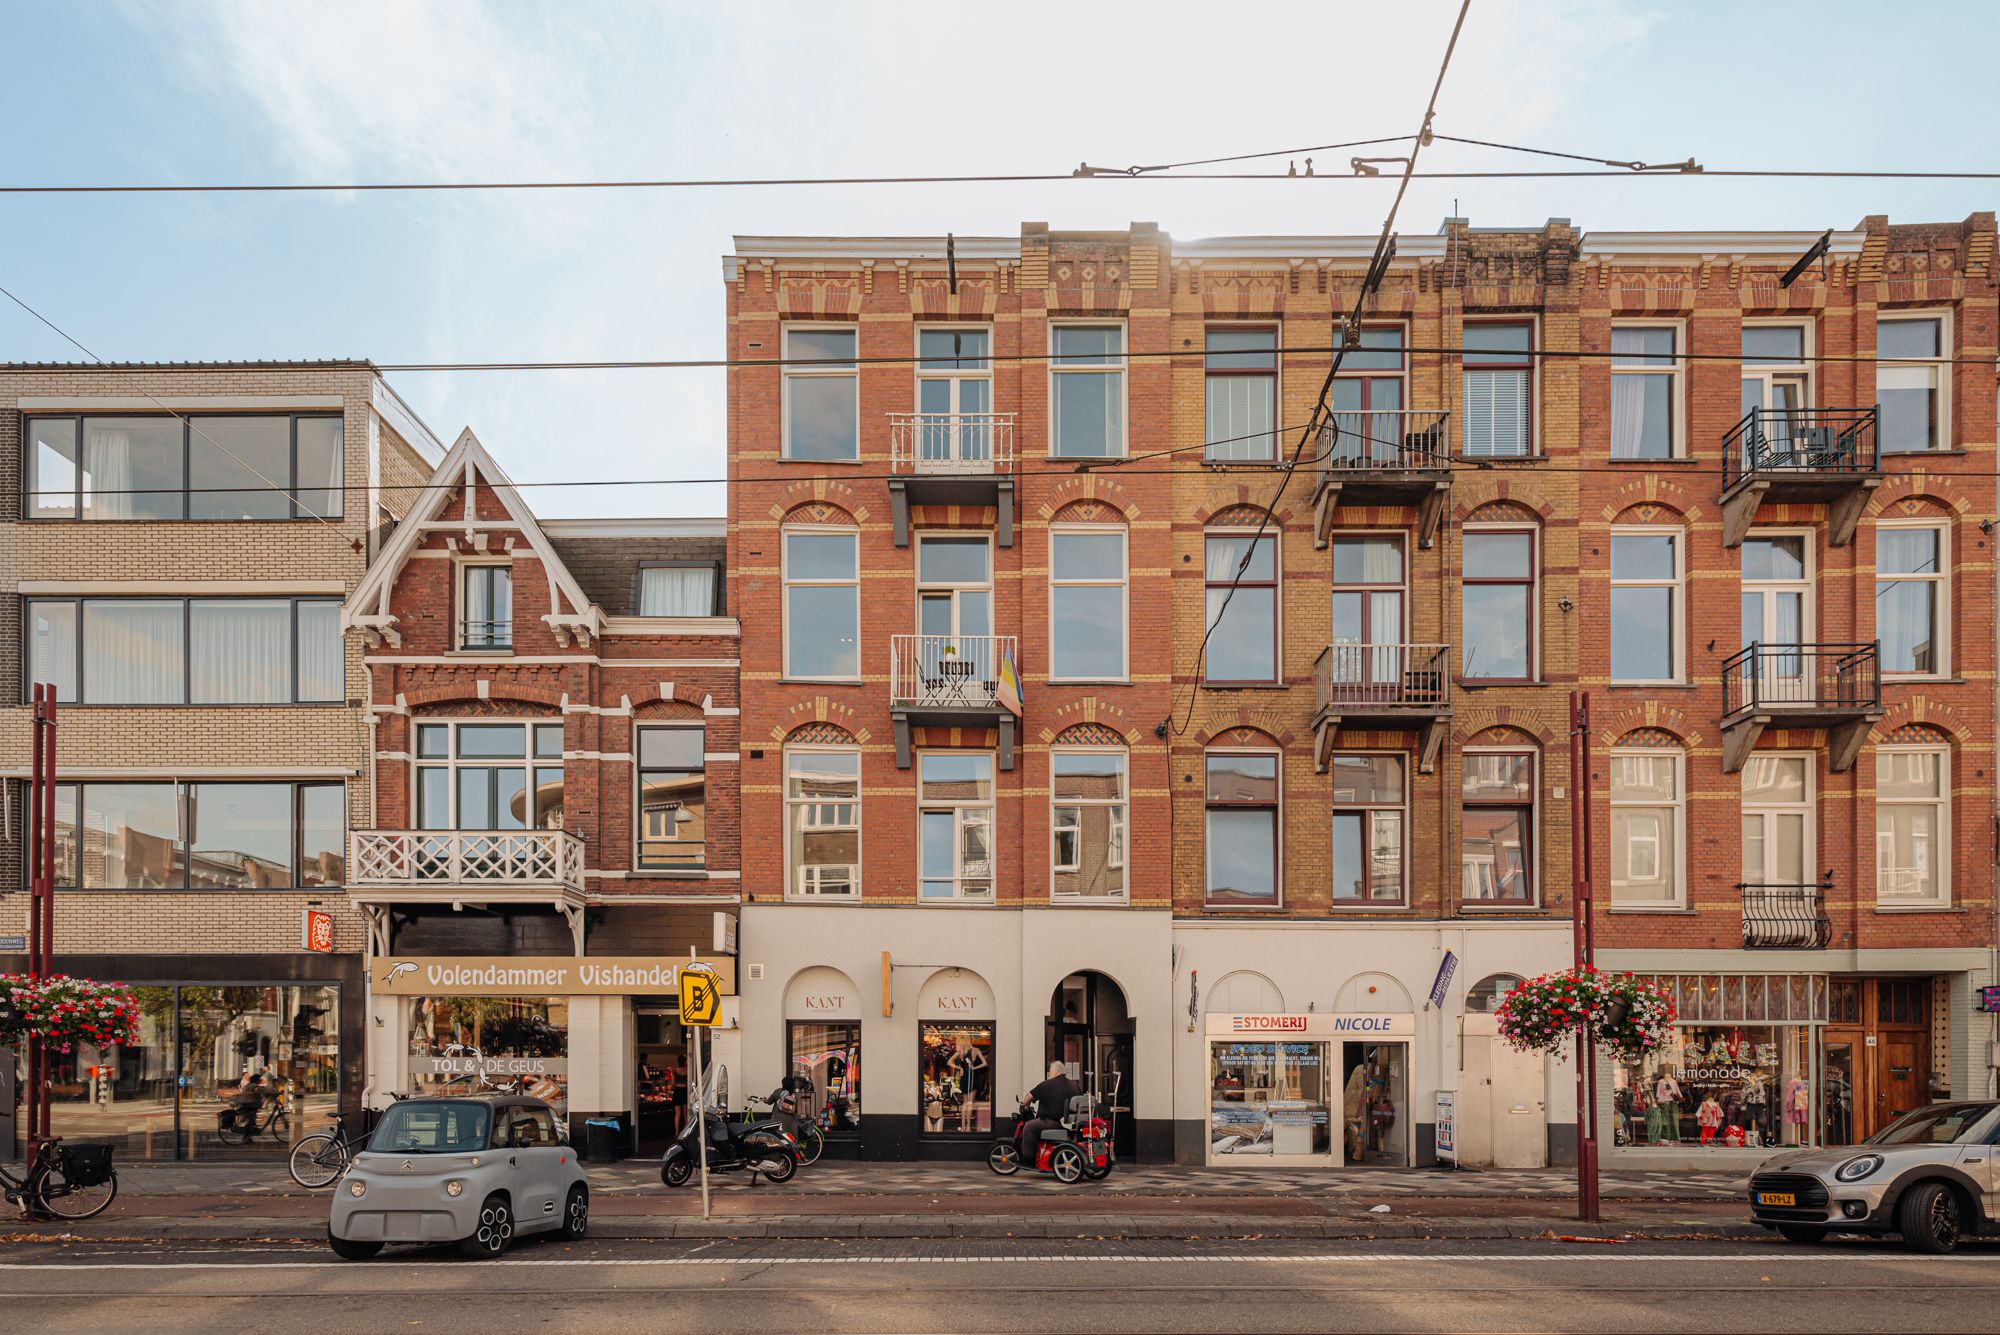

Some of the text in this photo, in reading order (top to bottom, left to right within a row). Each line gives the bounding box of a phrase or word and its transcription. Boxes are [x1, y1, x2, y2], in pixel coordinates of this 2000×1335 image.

[427, 964, 679, 986] Volendammer Vishandel
[1442, 958, 1458, 994] REPARATIE
[1432, 972, 1447, 1003] KLEDING
[805, 996, 845, 1009] KANT
[938, 996, 977, 1009] KANT
[1334, 1017, 1392, 1031] NICOLE
[1230, 1043, 1265, 1054] SPOED
[1684, 1040, 1779, 1067] SALE
[432, 1059, 545, 1073] TOL & DE GEUS
[1672, 1065, 1751, 1079] lemonade
